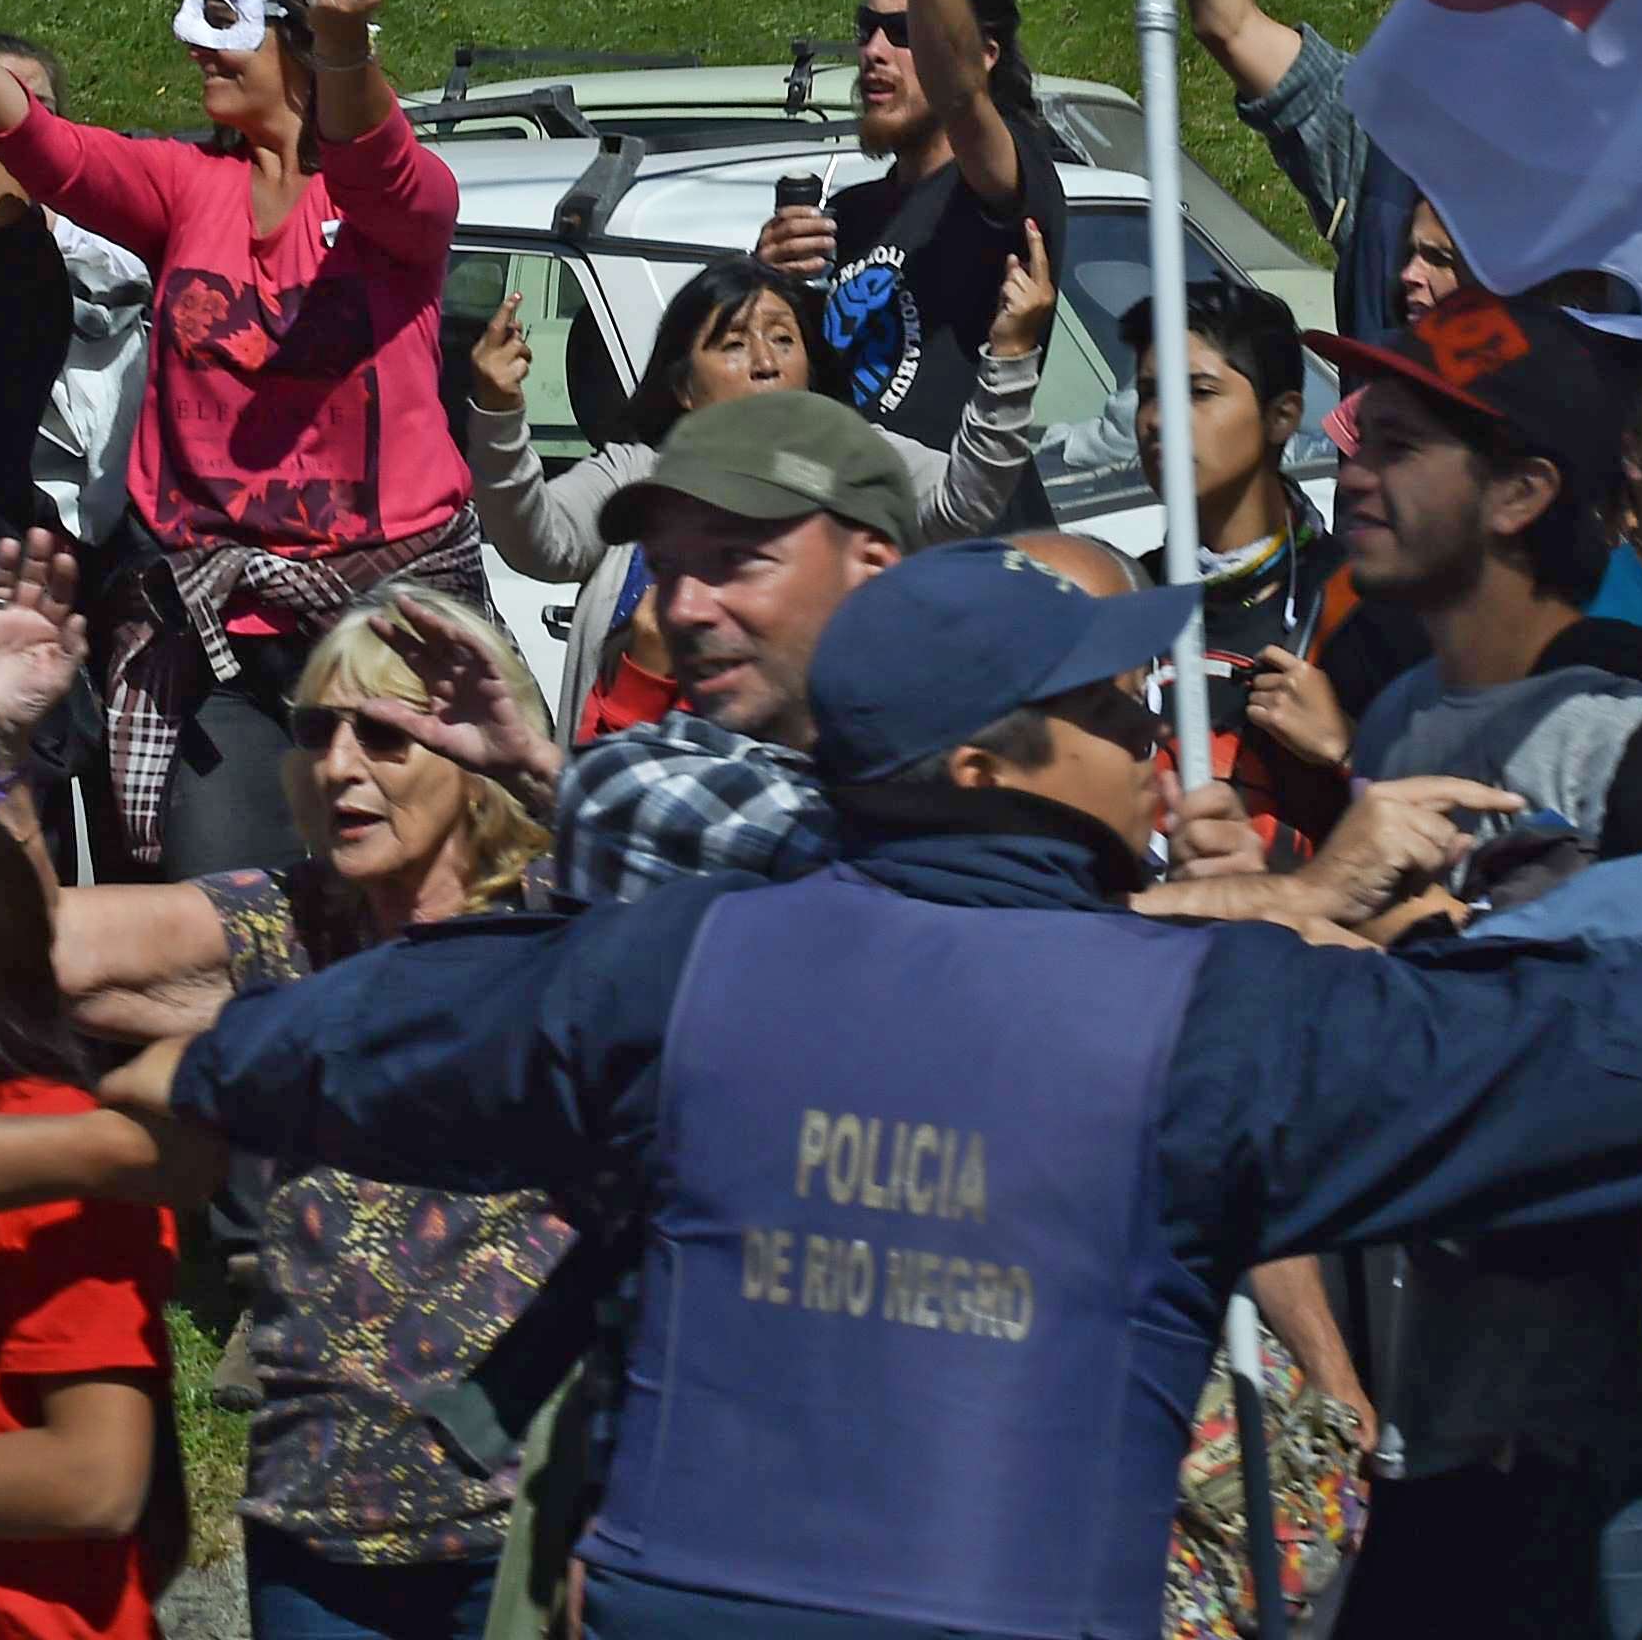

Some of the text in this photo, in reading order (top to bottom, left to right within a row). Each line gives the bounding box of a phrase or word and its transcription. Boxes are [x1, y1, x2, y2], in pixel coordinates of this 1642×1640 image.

[796, 1109, 988, 1224] POLICIA
[742, 1226, 1035, 1342] DE RIO NEGRO
